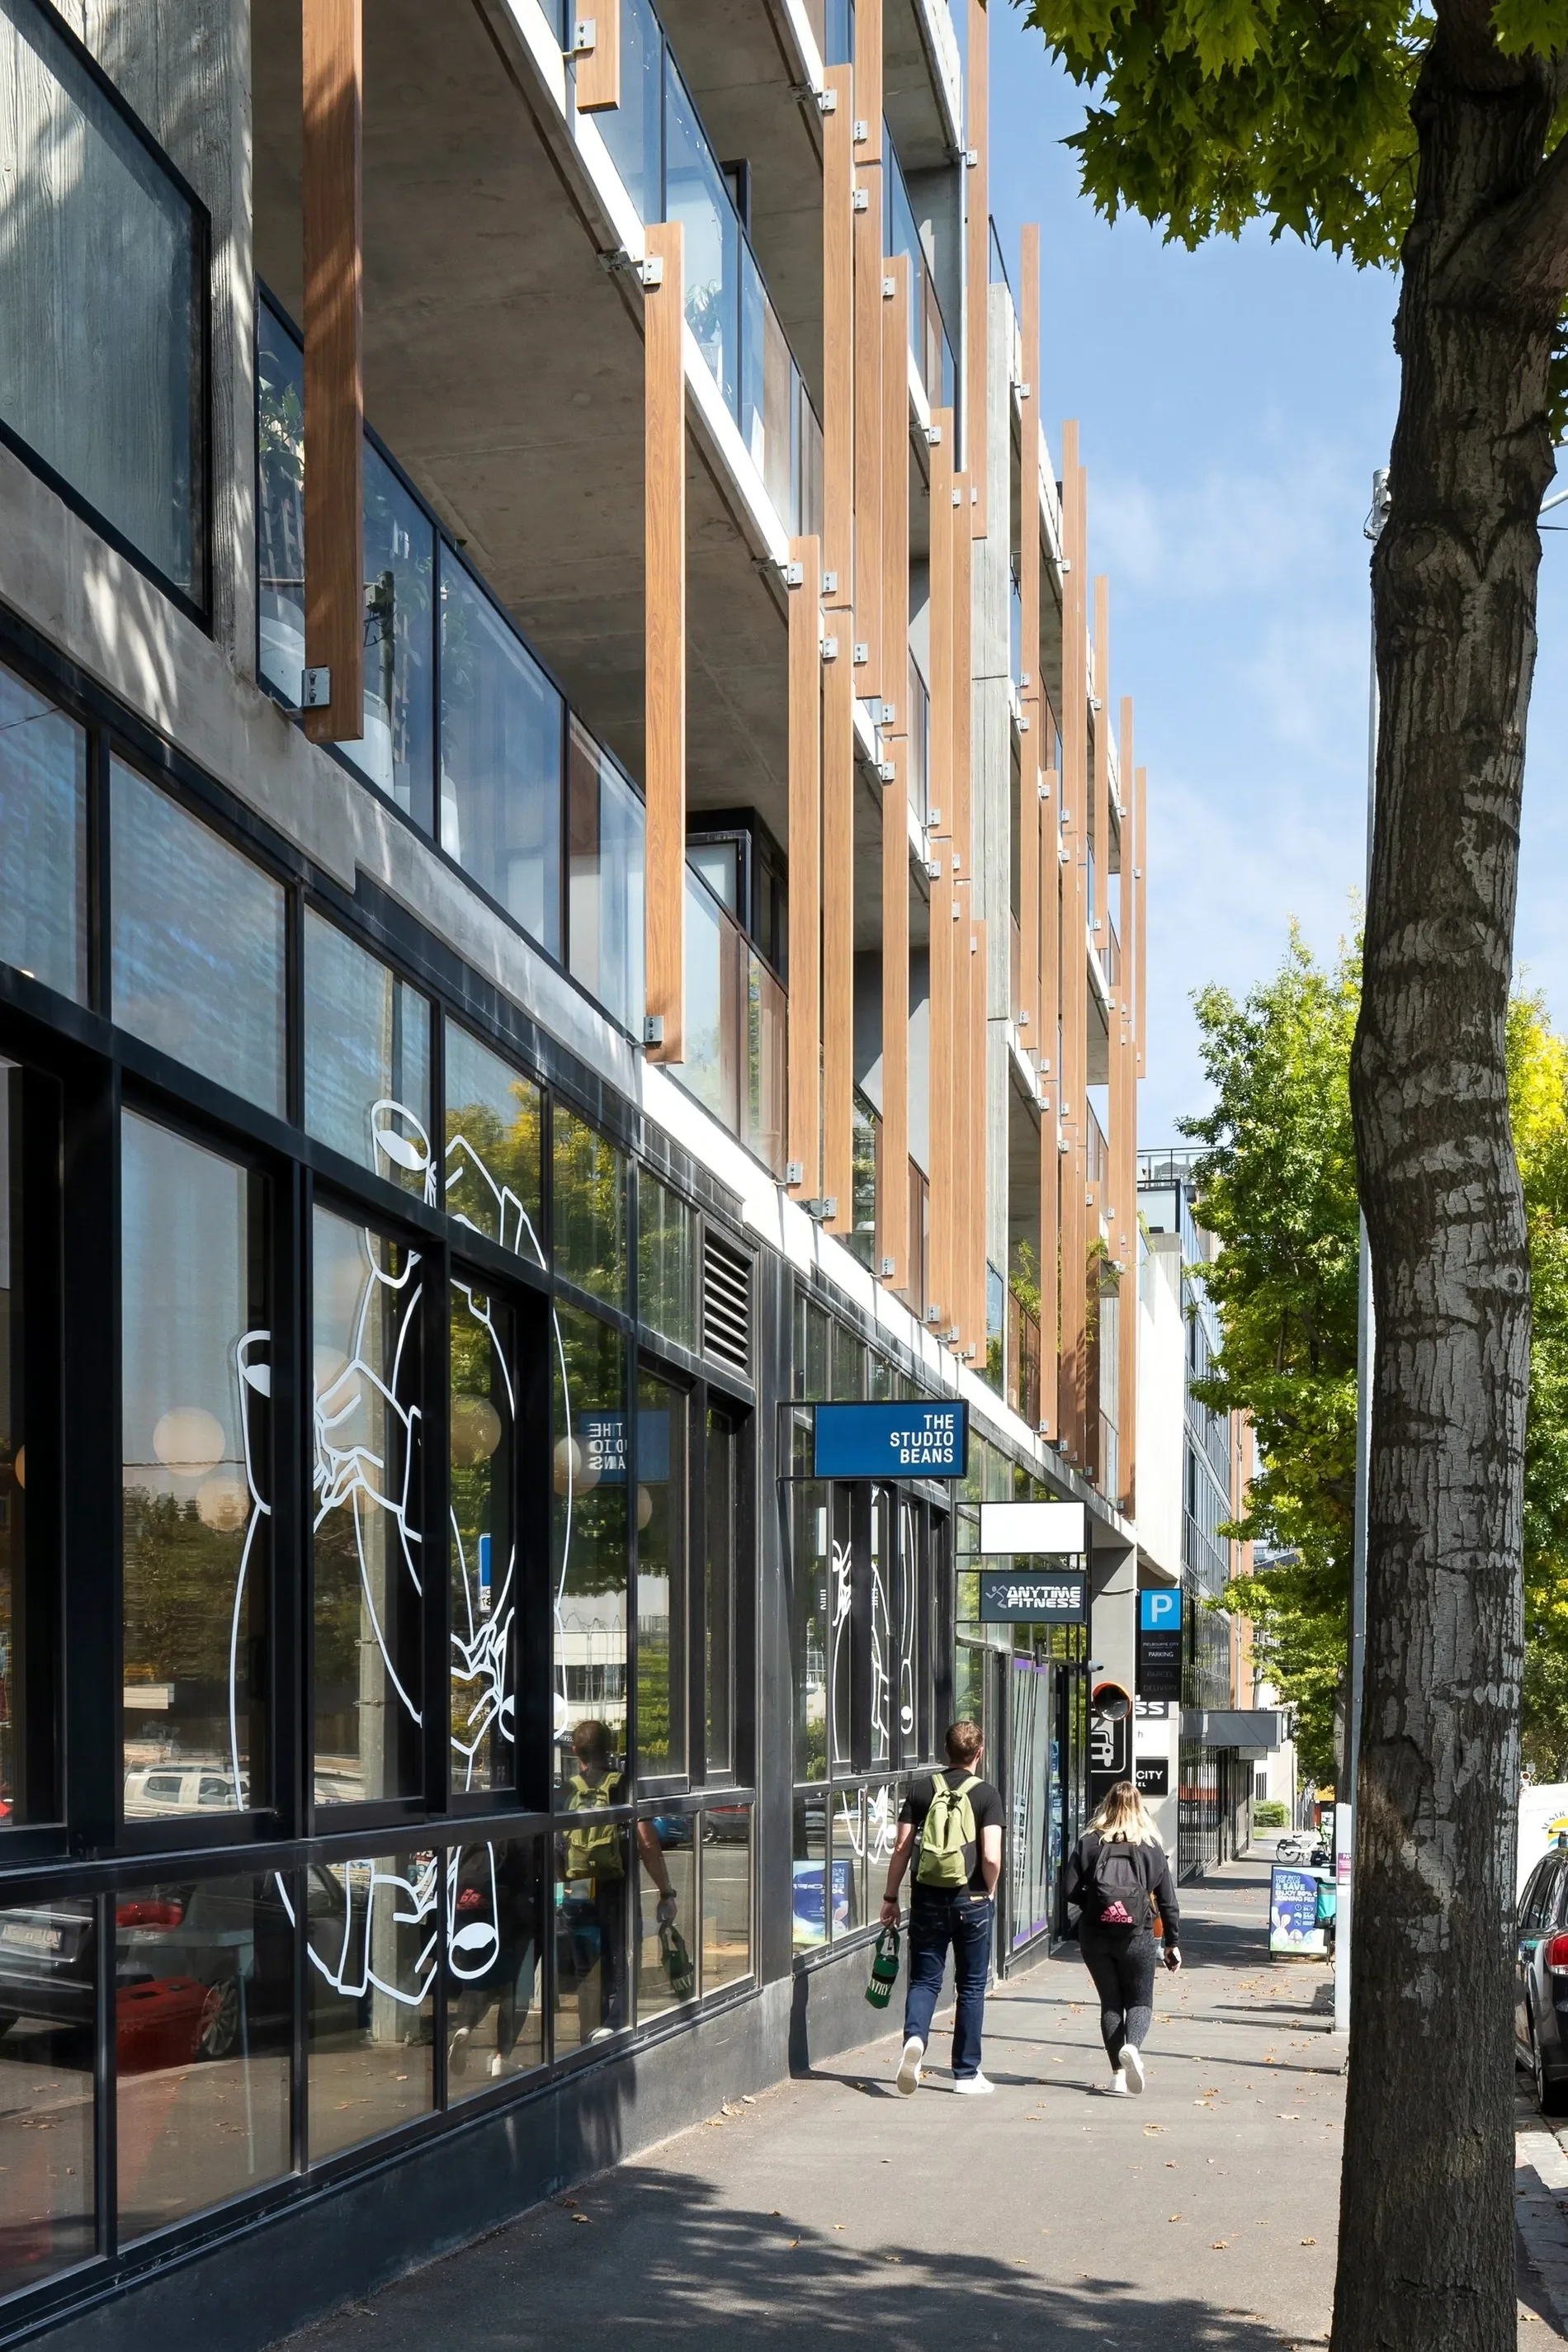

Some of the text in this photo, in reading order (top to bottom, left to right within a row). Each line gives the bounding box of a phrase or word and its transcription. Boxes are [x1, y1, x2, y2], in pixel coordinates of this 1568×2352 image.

[923, 1414, 954, 1429] THE
[890, 1431, 954, 1448] STUDIO
[900, 1448, 953, 1464] BEANS
[1007, 1585, 1081, 1599] ANYTIME
[1008, 1598, 1081, 1608] FITNESS
[1151, 1594, 1173, 1622] P
[1136, 1770, 1164, 1780] CITY
[1100, 1915, 1133, 1924] adidas
